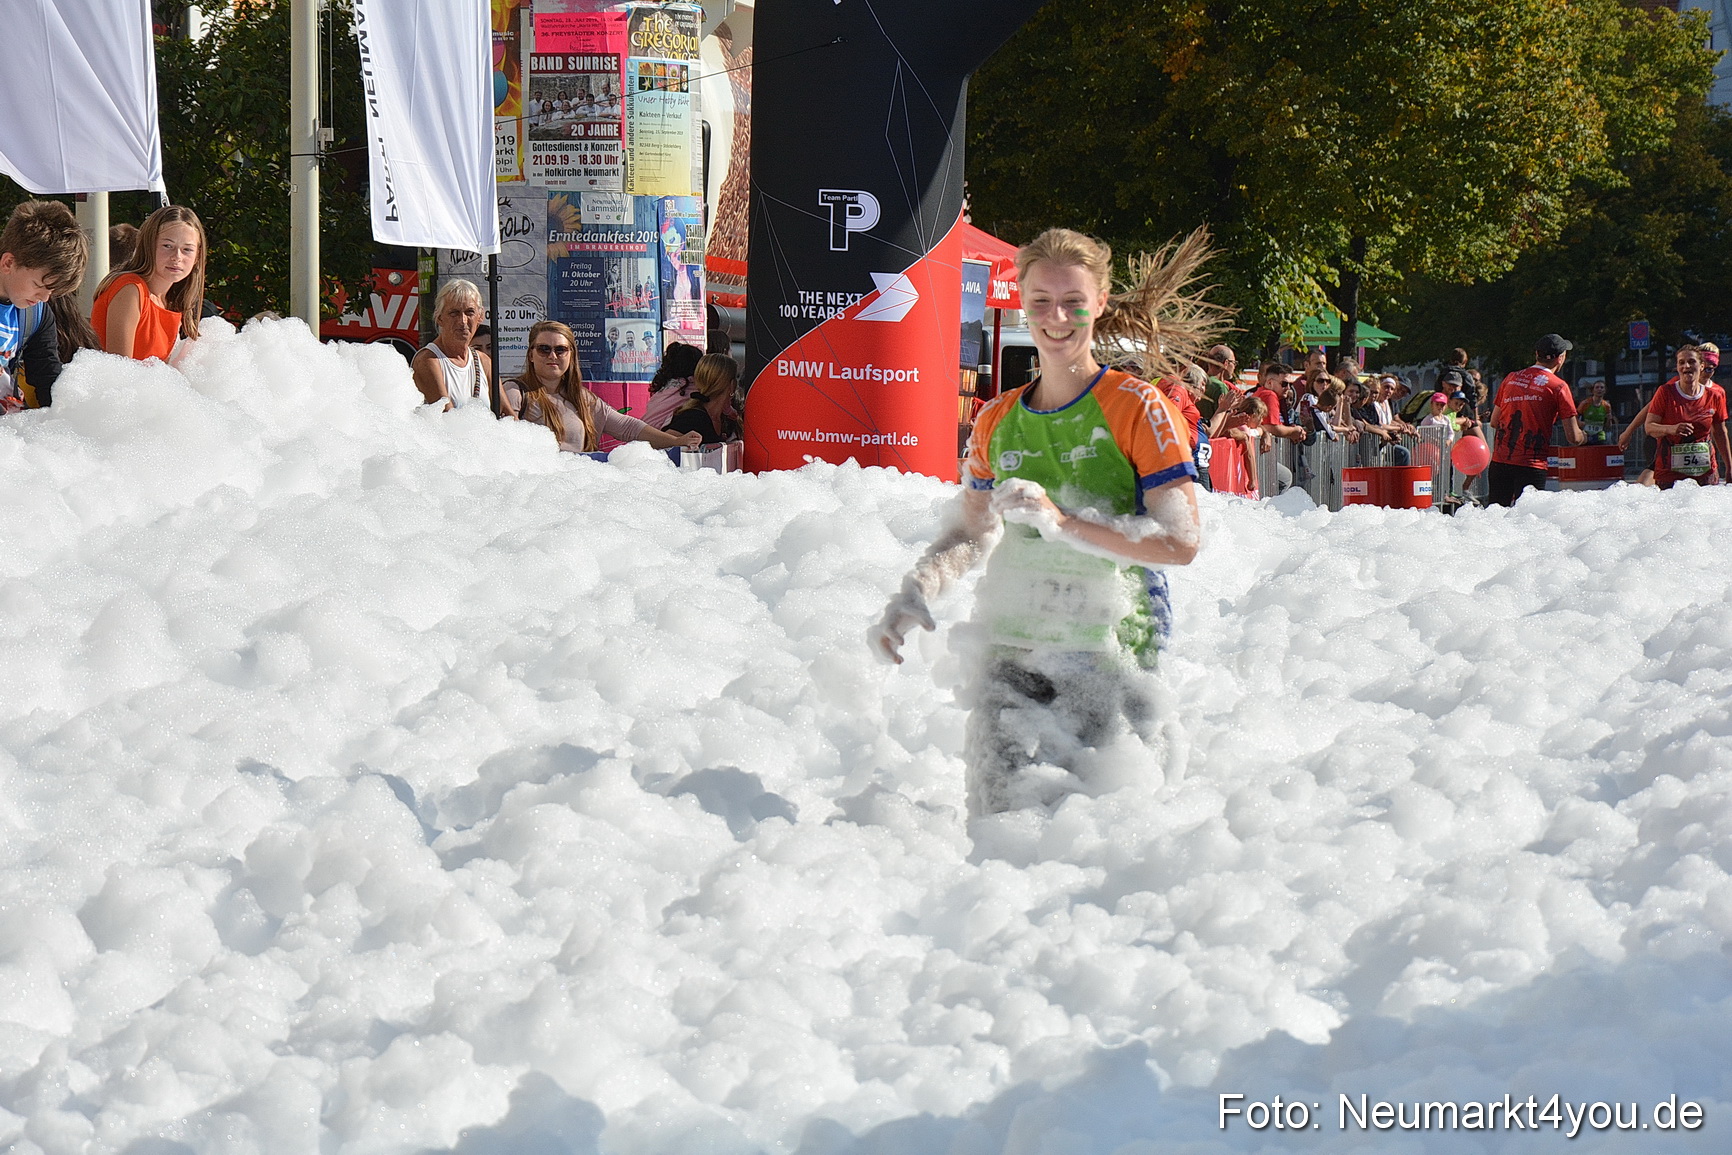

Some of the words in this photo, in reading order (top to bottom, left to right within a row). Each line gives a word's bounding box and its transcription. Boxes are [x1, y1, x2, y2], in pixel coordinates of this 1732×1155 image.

[643, 11, 672, 33] The
[531, 56, 563, 70] BAND
[568, 56, 618, 70] SUNRISE
[571, 125, 584, 136] 20
[588, 125, 619, 136] JAHRE
[533, 142, 582, 152] Gottesdienst
[584, 143, 589, 151] &
[591, 142, 619, 152] Konzert
[533, 154, 569, 165] 21.09.19
[578, 154, 602, 165] 18.30
[604, 154, 619, 165] Uhr
[545, 167, 582, 177] Hofkirche
[584, 167, 619, 177] Neumarkt
[549, 230, 634, 244] Erntedankfest
[636, 231, 659, 243] 2019
[570, 262, 592, 270] Freitag
[965, 281, 982, 294] AVIA.
[798, 291, 826, 305] THE
[830, 292, 864, 306] NEXT
[505, 310, 516, 319] 20
[519, 310, 535, 320] Uhr
[778, 305, 798, 318] 100
[801, 305, 846, 320] YEARS
[568, 322, 595, 331] Samstag
[777, 360, 824, 378] BMW
[828, 362, 920, 385] Laufsport
[777, 428, 918, 447] www.bmw-partl.de
[1684, 456, 1698, 465] 54
